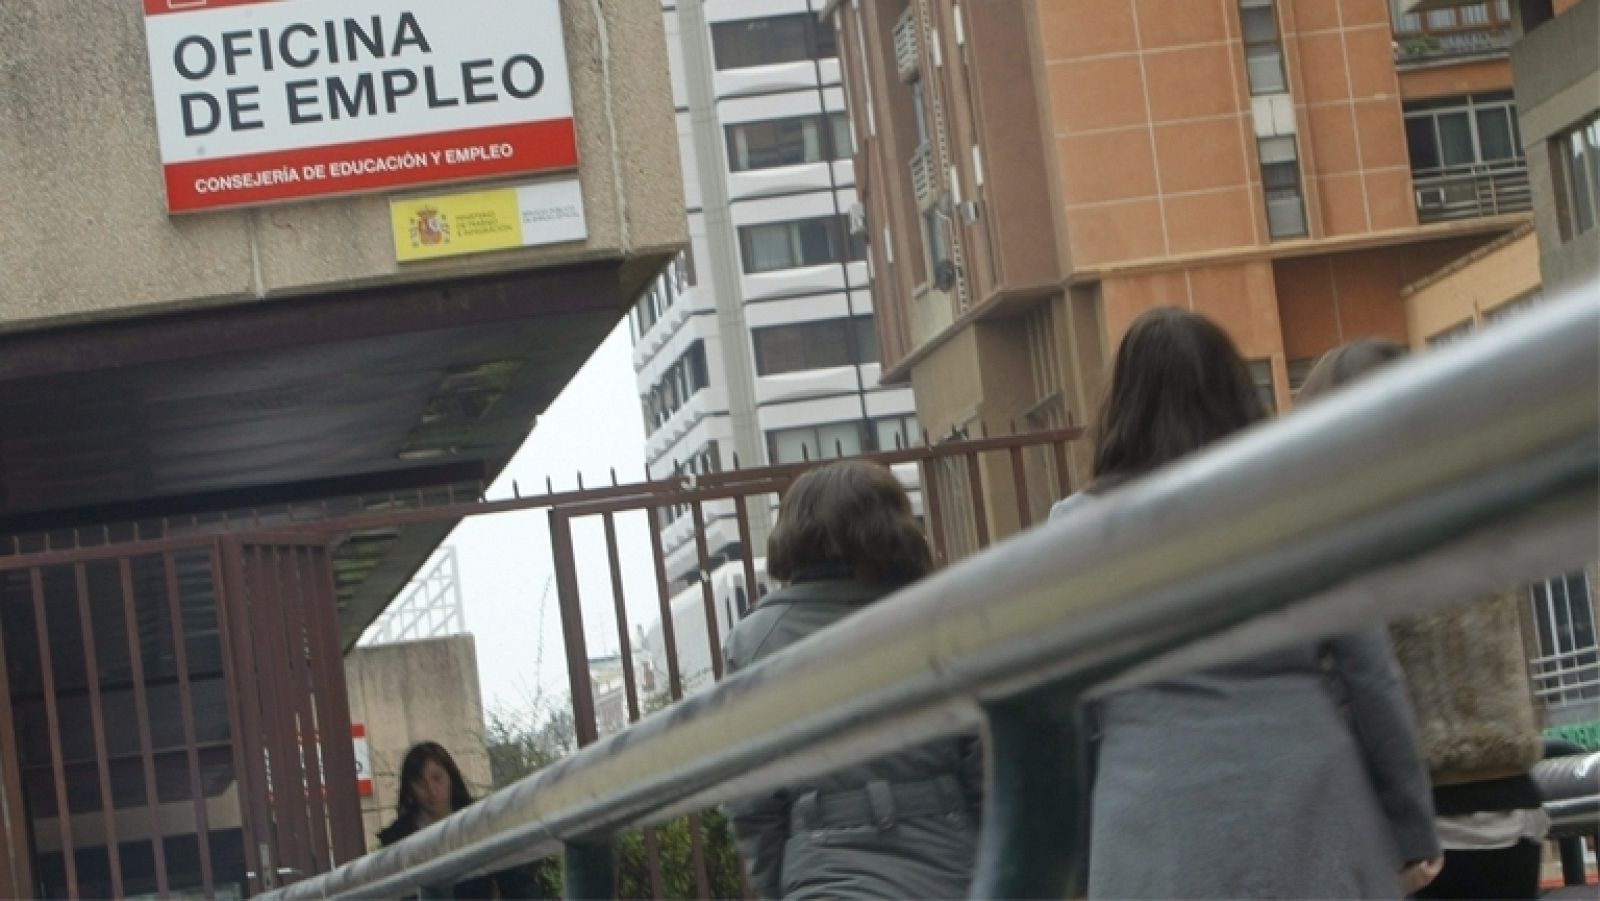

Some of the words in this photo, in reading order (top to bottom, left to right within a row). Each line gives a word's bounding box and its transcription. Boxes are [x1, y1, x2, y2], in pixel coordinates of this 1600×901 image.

[174, 11, 432, 80] OFICINA
[180, 85, 265, 137] DE
[285, 53, 545, 125] EMPLEO
[195, 165, 301, 193] CONSEJERÍA
[302, 164, 326, 181] DE
[329, 150, 428, 178] EDUCACIÓN
[430, 151, 441, 166] Y
[444, 143, 514, 164] EMPLEO
